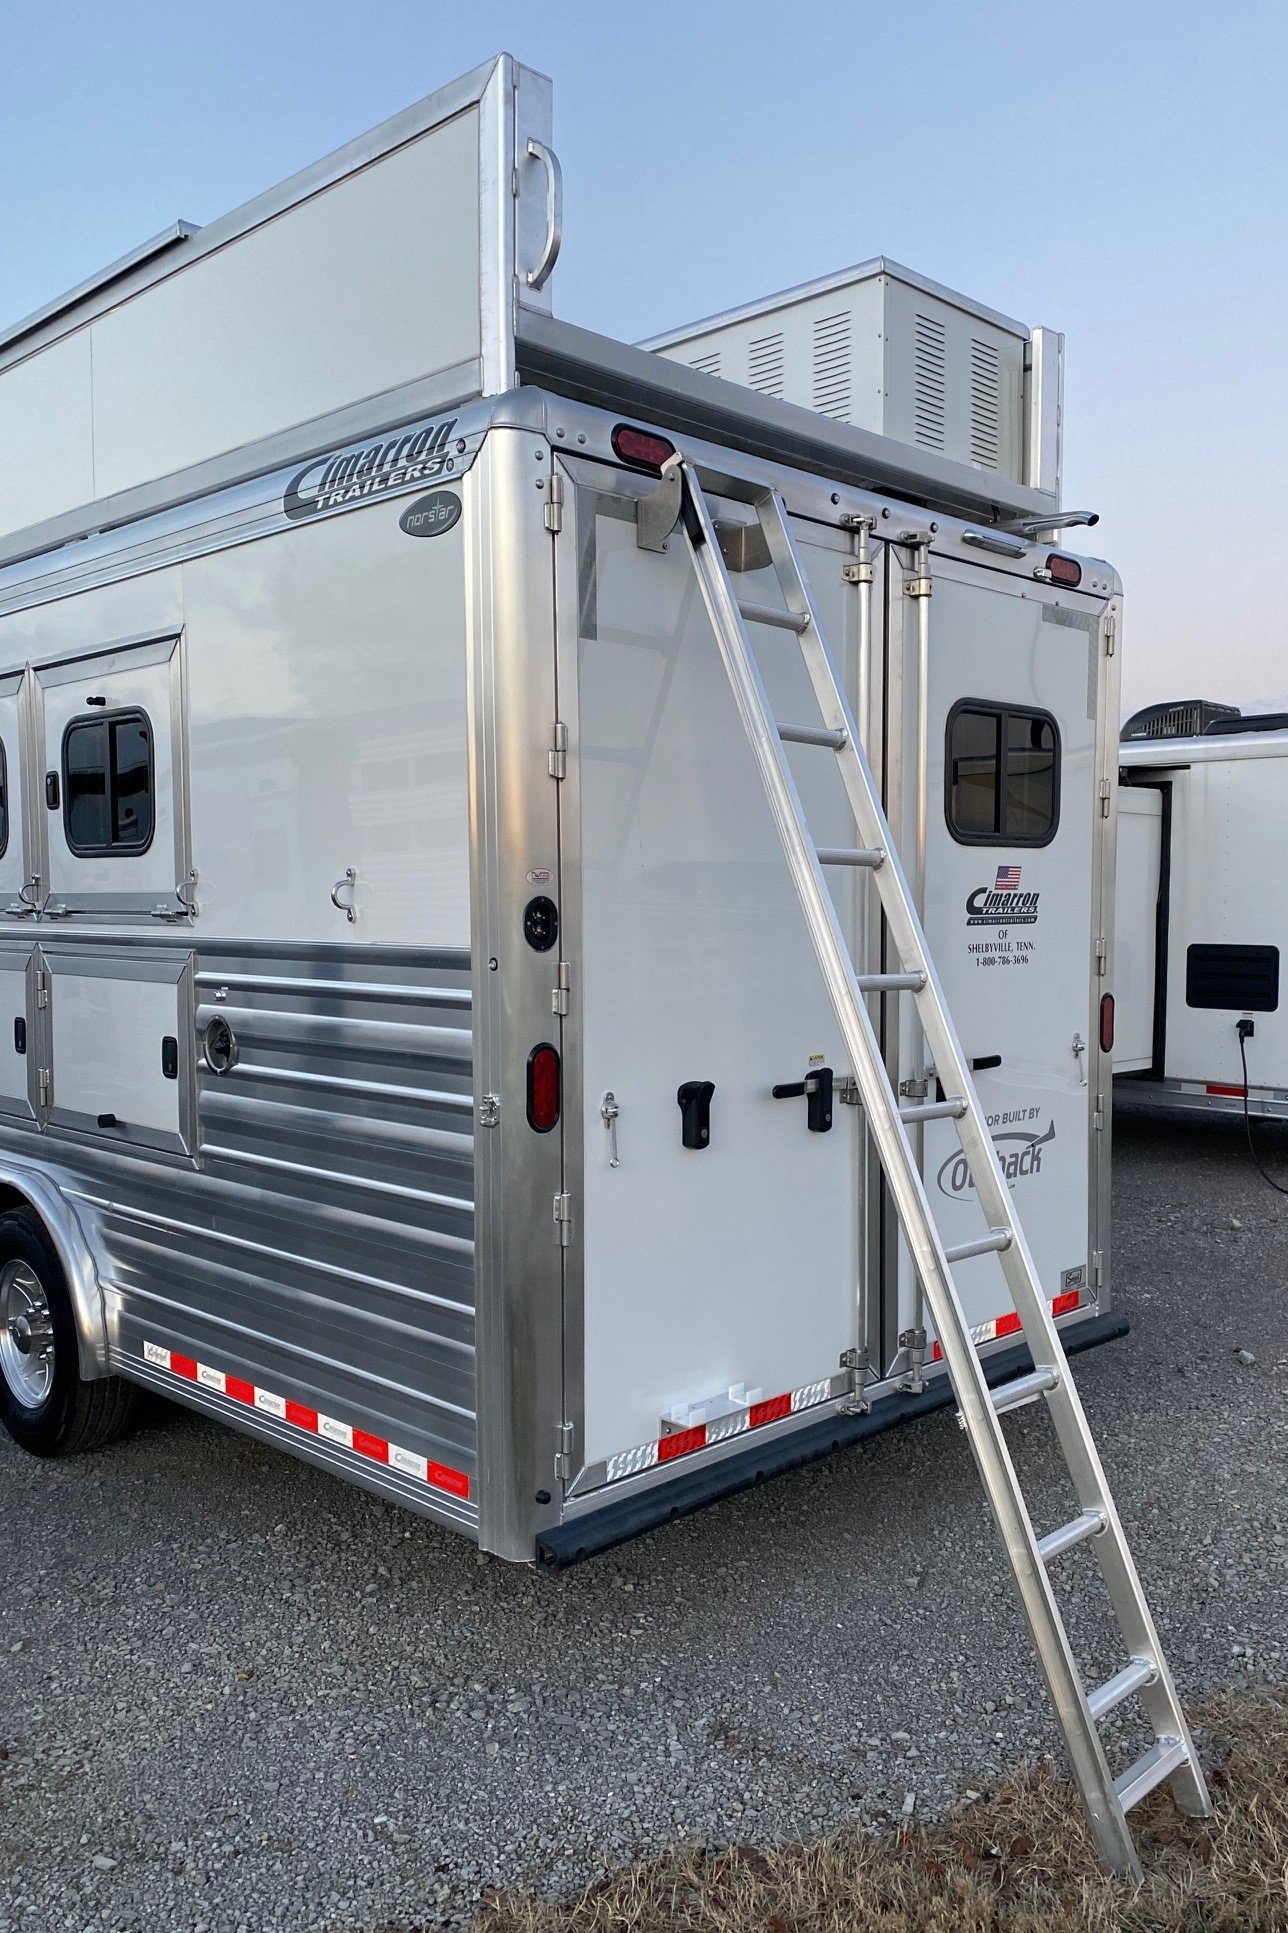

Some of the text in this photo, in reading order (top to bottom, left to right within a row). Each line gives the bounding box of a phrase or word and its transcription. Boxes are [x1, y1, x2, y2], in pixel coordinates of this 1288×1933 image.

[283, 416, 460, 521] Cimarron
[314, 456, 443, 510] TRAILERS
[406, 497, 455, 528] norstar
[965, 886, 1040, 915] Cimarron
[981, 906, 1035, 915] TRAILERS
[997, 929, 1009, 940] OF
[967, 941, 1036, 954] SHELBYVILLE, TENN.
[975, 954, 1029, 967] 1-800-786-3696
[1001, 1108, 1027, 1124] BUILT
[1028, 1106, 1041, 1120] BY
